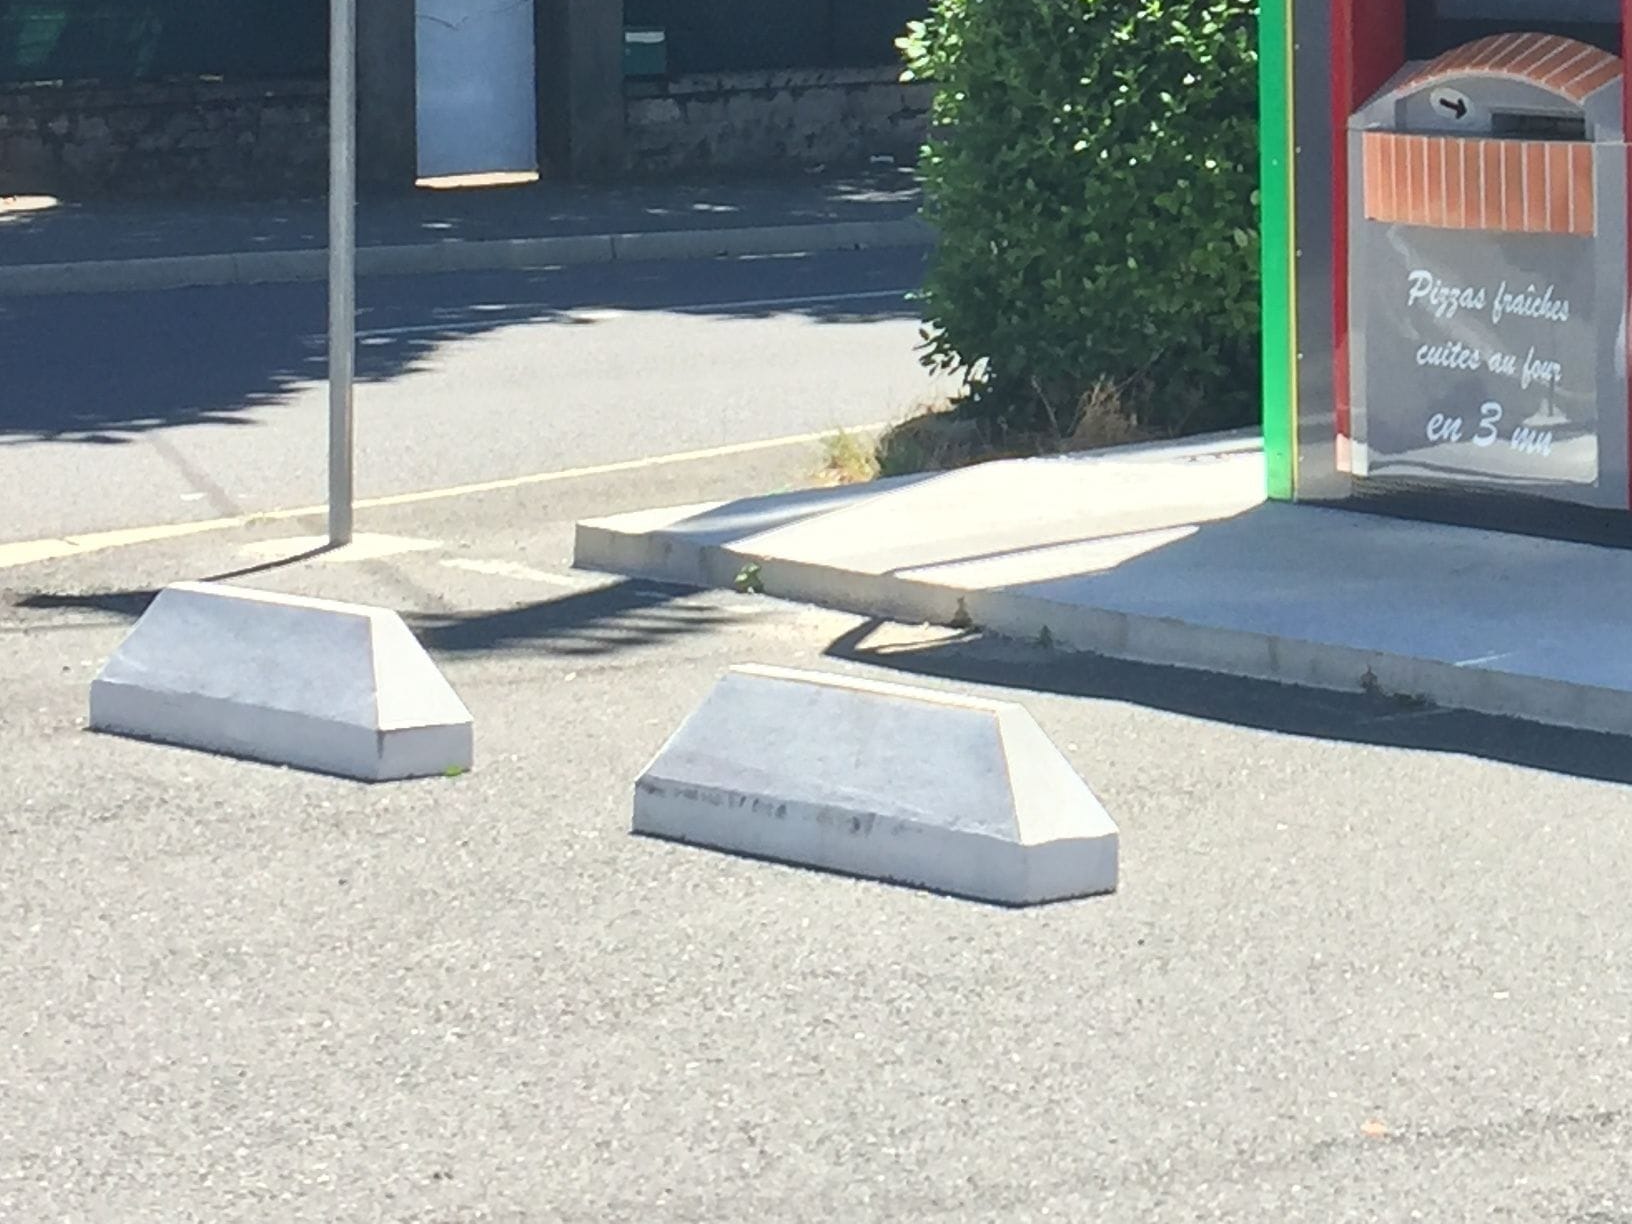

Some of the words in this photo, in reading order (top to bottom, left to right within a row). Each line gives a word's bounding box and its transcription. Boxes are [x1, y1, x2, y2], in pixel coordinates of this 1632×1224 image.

[1408, 270, 1487, 319] Pizzas
[1492, 280, 1570, 324] fraîches
[1416, 340, 1481, 371] cuites
[1487, 351, 1517, 376] au
[1521, 345, 1562, 390] four
[1426, 413, 1463, 442] en
[1472, 401, 1502, 447] 3
